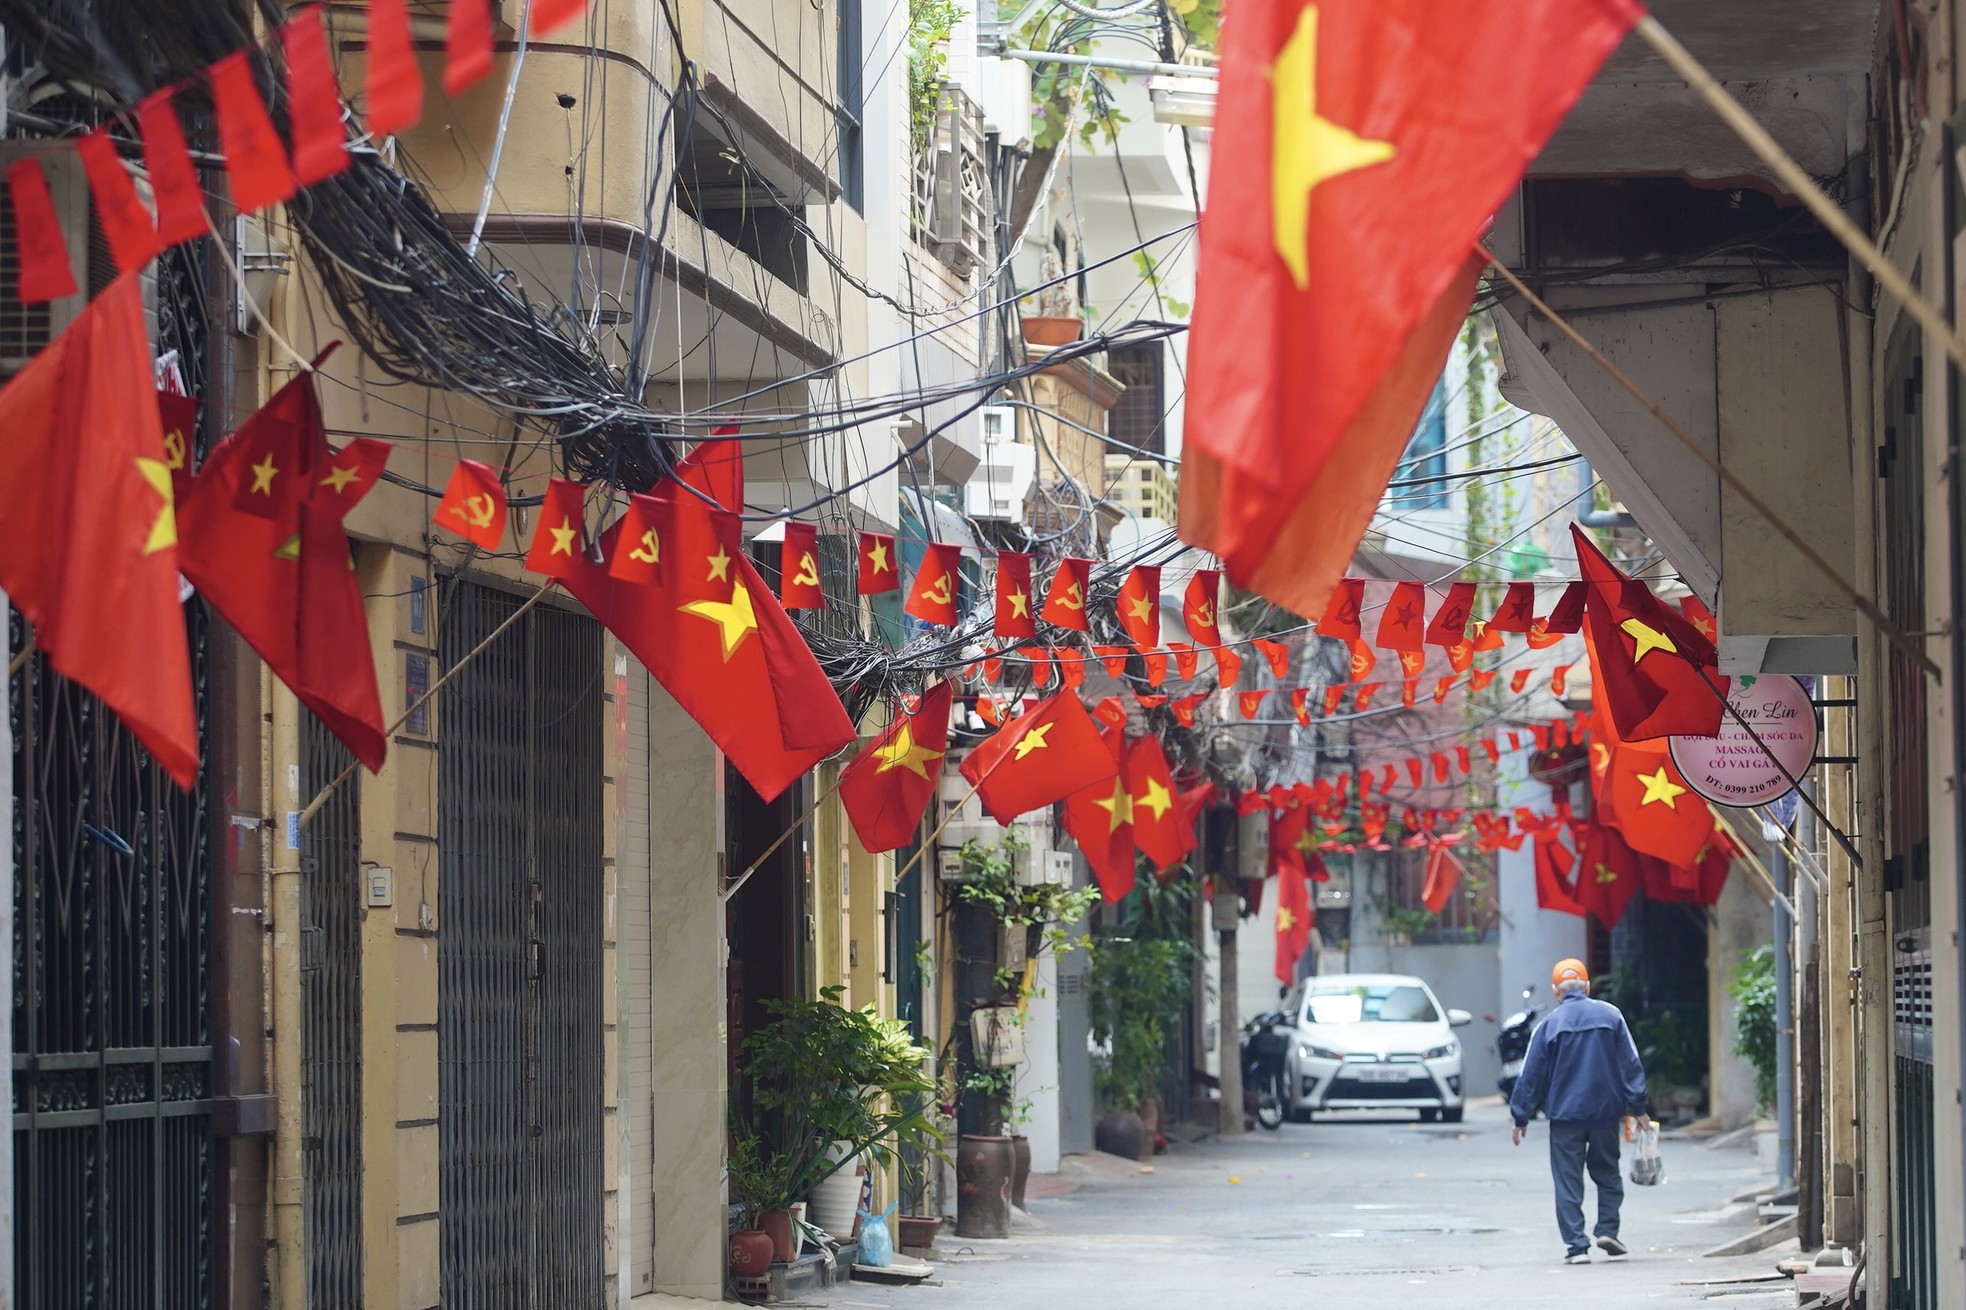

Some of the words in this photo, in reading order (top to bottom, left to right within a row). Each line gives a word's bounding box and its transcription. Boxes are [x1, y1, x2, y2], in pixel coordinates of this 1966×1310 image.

[1762, 700, 1798, 719] Lin
[1734, 732, 1764, 740] CHM
[1767, 731, 1788, 740] SÓC
[1715, 745, 1772, 755] MASSAG
[1729, 760, 1750, 769] VAI
[1753, 757, 1777, 769] GÁ
[1725, 784, 1747, 794] 0399
[1749, 783, 1765, 794] 210
[1766, 775, 1782, 788] 789
